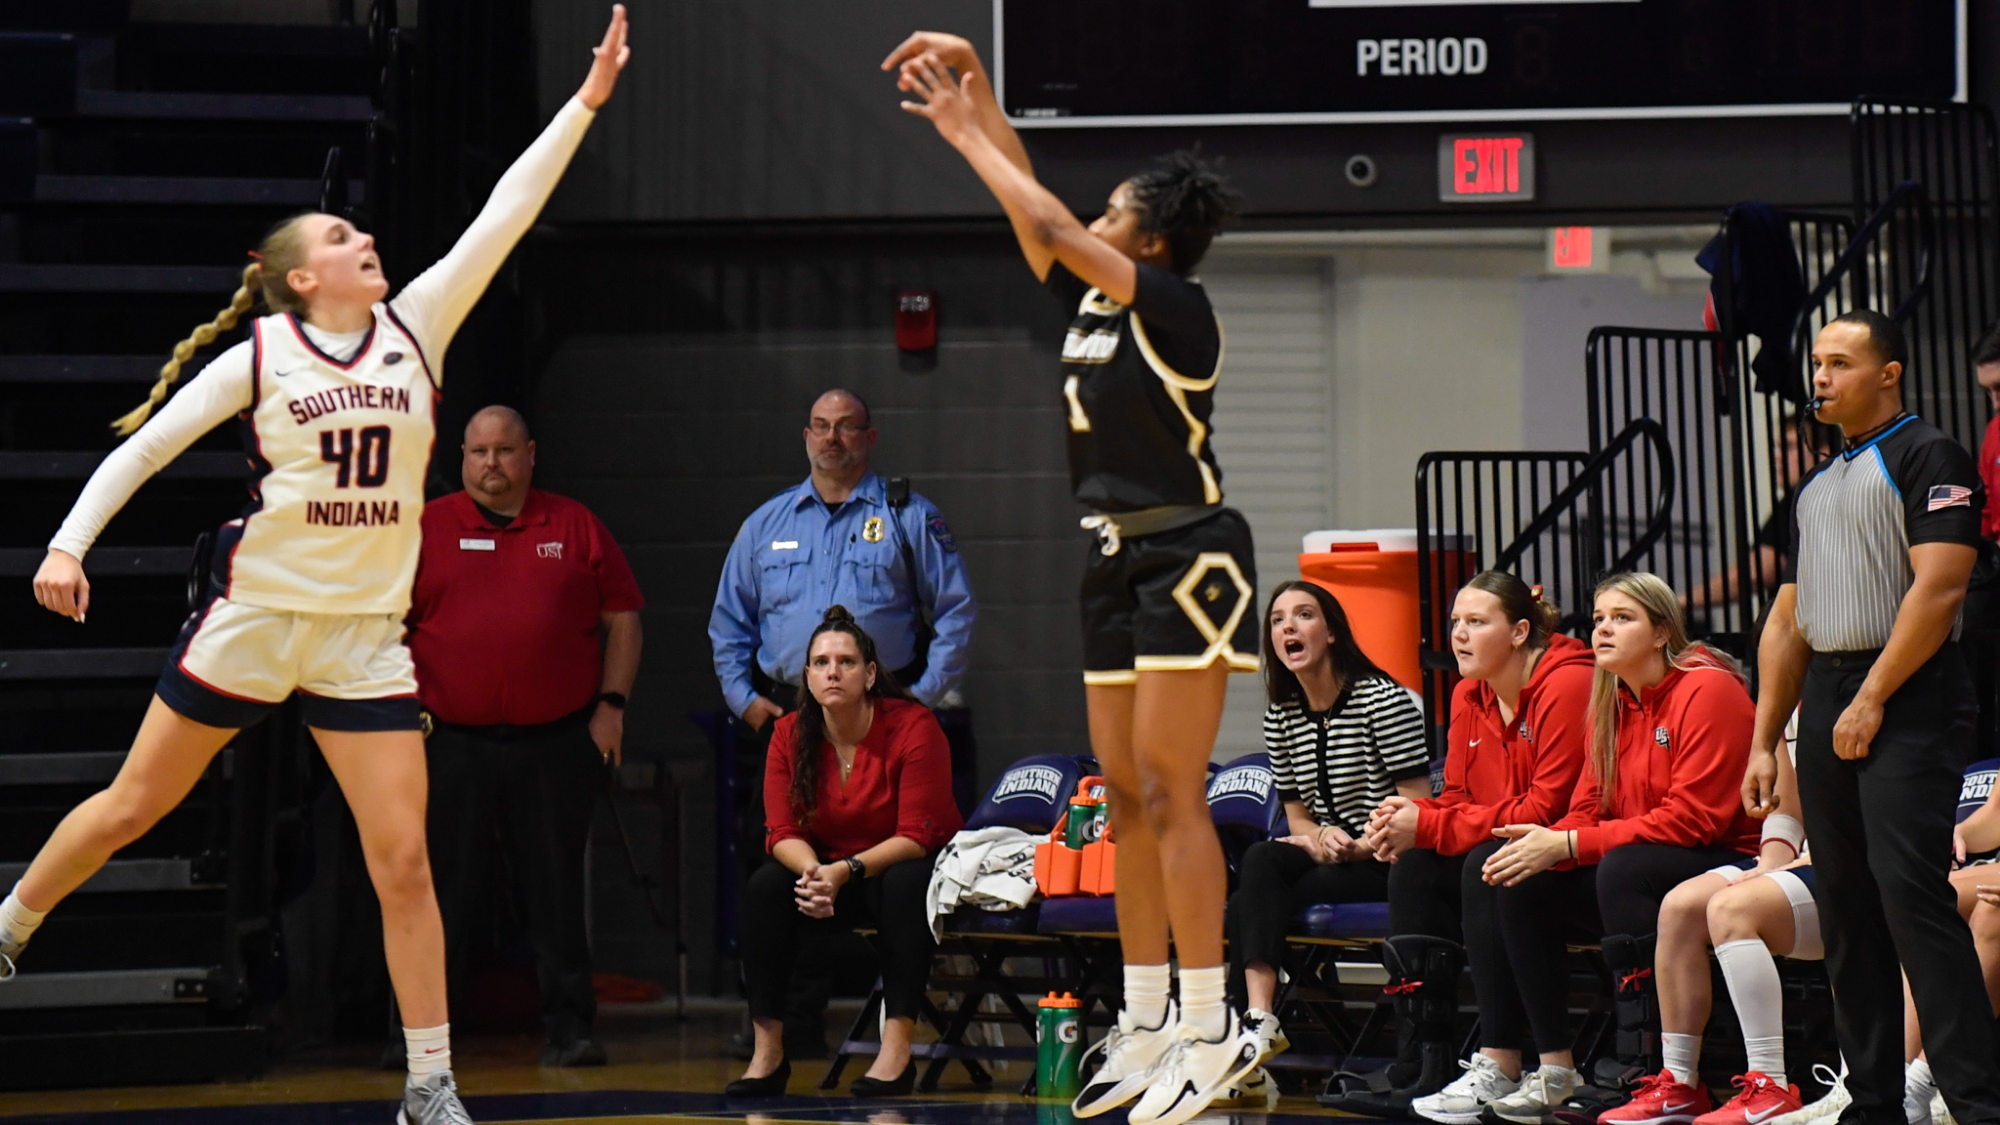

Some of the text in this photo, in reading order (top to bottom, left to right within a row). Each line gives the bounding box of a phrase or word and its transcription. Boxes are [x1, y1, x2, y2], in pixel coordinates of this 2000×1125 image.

[1357, 37, 1488, 76] PERIOD
[1454, 137, 1524, 193] EXIT
[288, 385, 411, 425] SOUTHERN
[1064, 374, 1091, 433] 1
[319, 424, 391, 489] 40
[306, 501, 400, 527] INDIANA
[996, 778, 1058, 800] INDIANA
[1004, 768, 1061, 788] SOUTHERN
[1207, 778, 1270, 799] INDIANA
[1058, 1020, 1078, 1044] G
